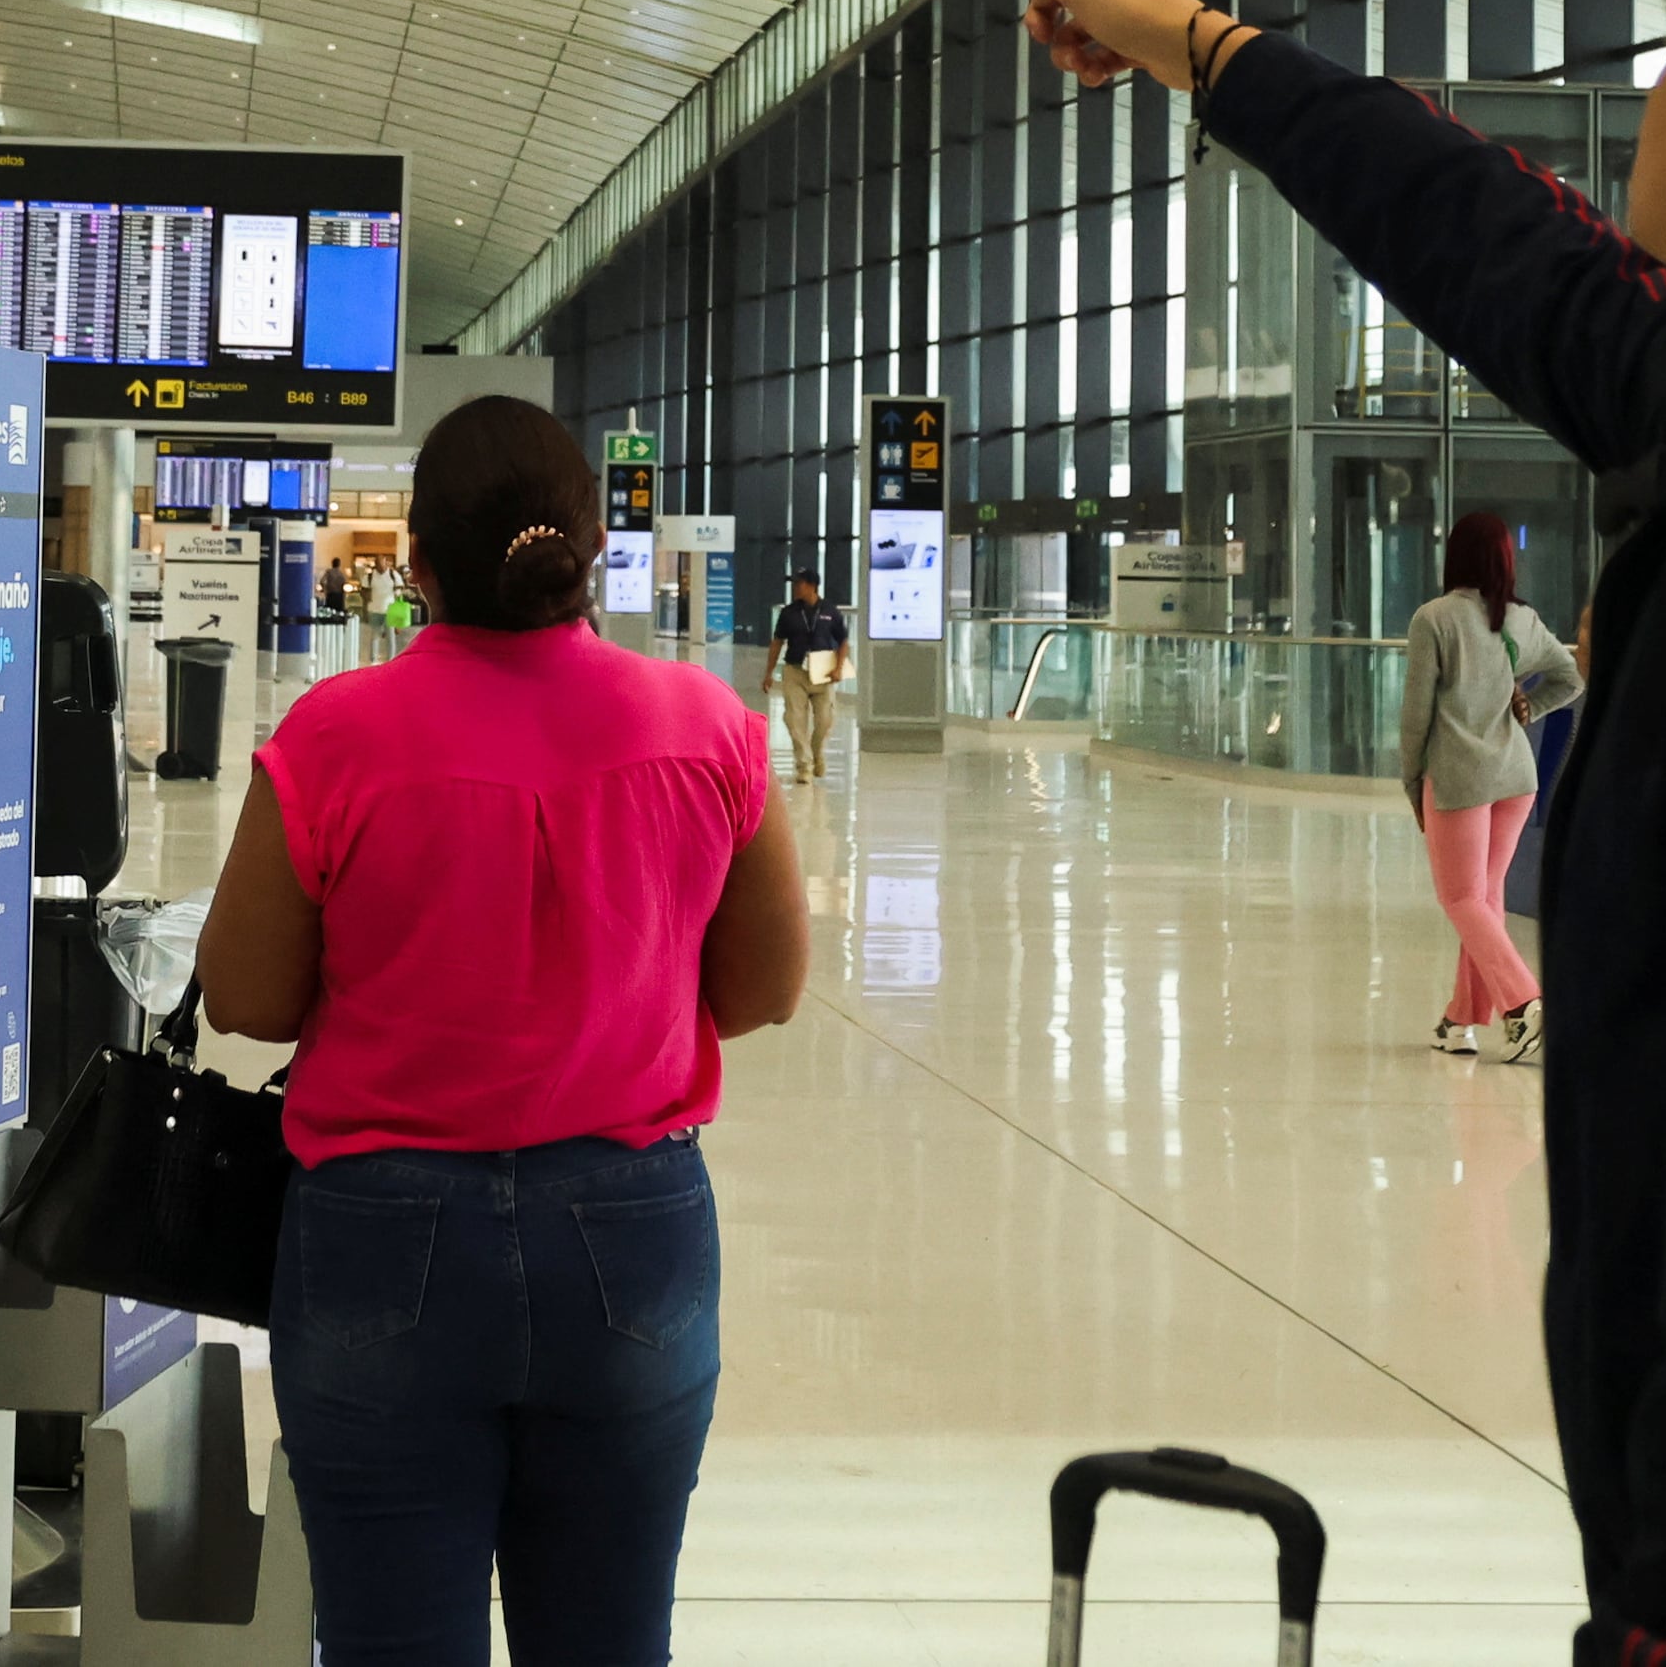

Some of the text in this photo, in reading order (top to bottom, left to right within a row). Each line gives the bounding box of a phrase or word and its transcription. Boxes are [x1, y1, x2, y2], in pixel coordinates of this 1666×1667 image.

[287, 391, 368, 406] B46 B89
[193, 536, 224, 548] Copa
[179, 545, 223, 556] Airlines
[191, 579, 228, 590] Vuelos
[179, 591, 240, 602] Nacionales
[14, 799, 25, 819] del
